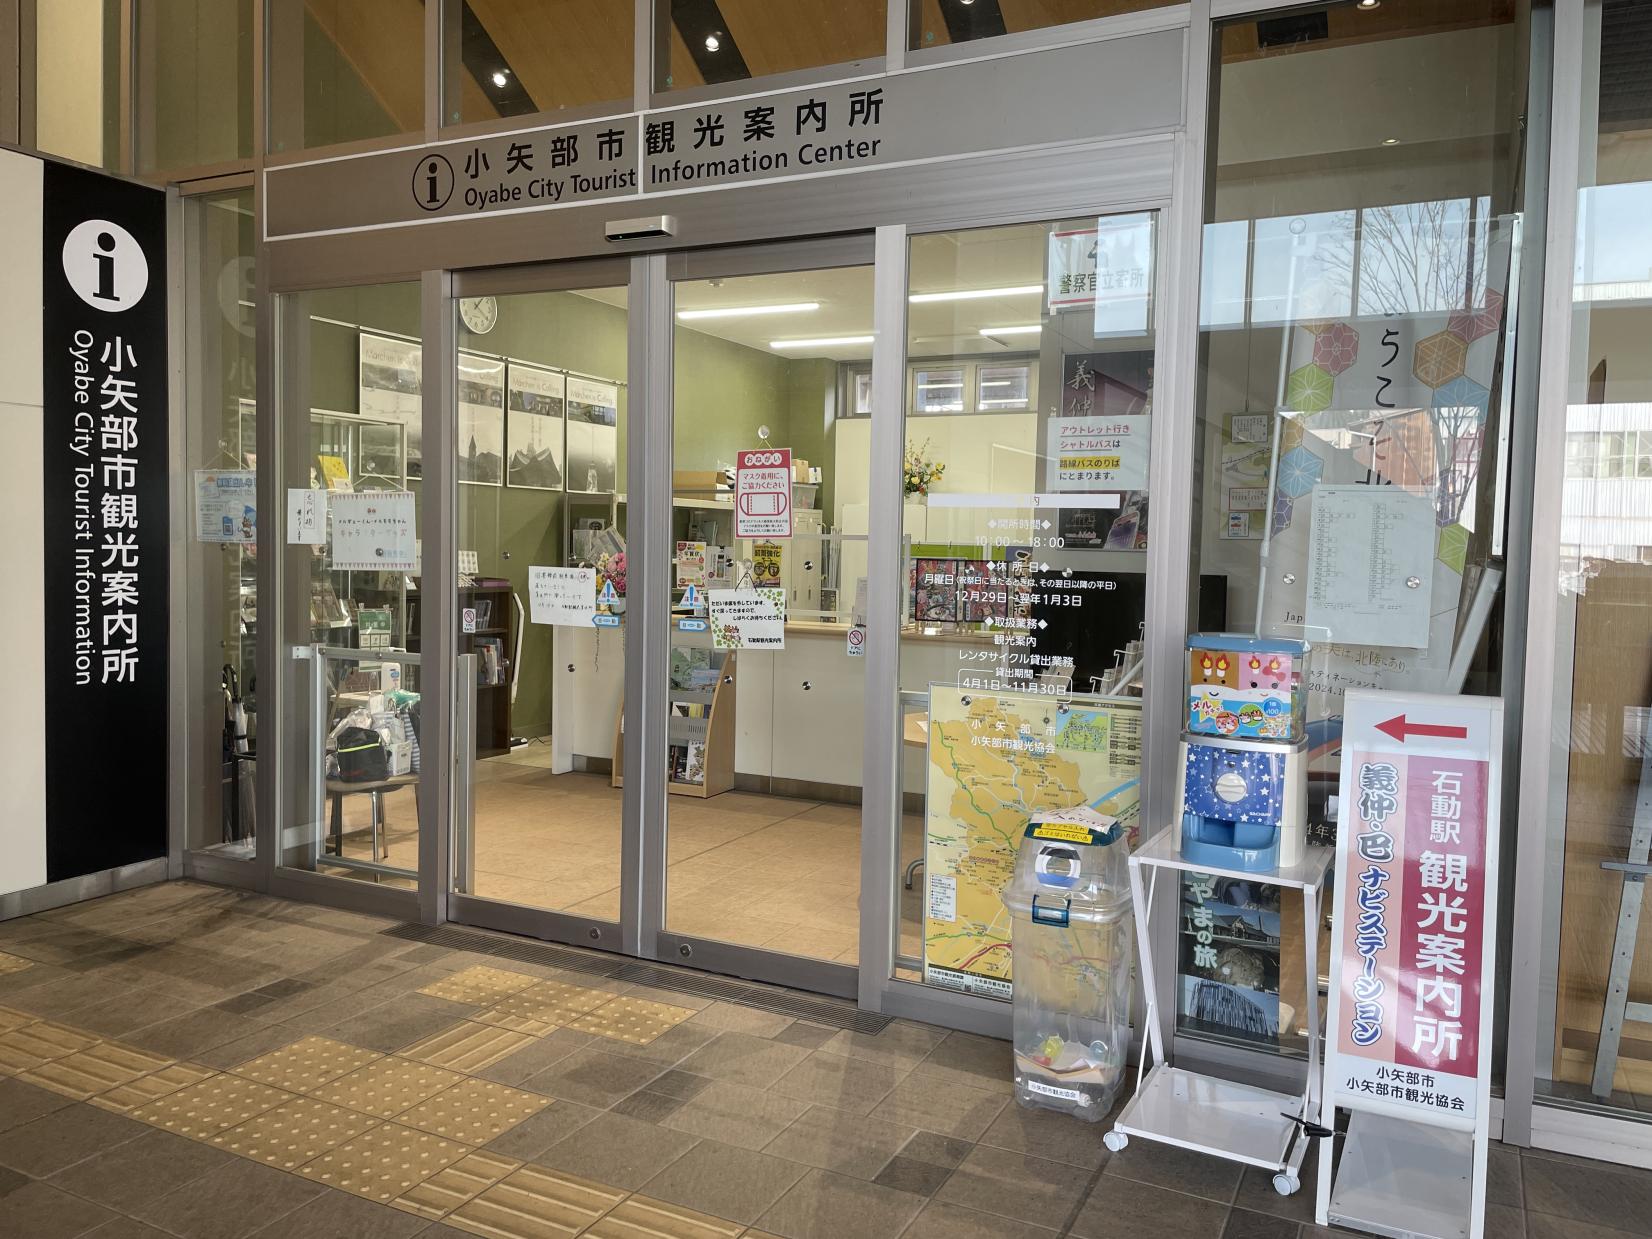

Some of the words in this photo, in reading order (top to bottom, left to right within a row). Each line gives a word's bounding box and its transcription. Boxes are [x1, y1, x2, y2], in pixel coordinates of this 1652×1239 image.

[464, 87, 884, 179] 小矢部市観光案内所
[465, 182, 522, 210] Oyabe
[528, 177, 565, 201] City
[570, 168, 637, 194] Tourist
[651, 150, 788, 184] Information
[798, 136, 881, 166] Center
[69, 328, 94, 405] Oyabe
[69, 411, 94, 457] City
[1061, 424, 1130, 434] アウトレット行き
[1060, 439, 1120, 449] シャトルバスは
[746, 453, 781, 465] おねがい
[1060, 457, 1120, 469] 路線バスのりば
[742, 481, 785, 490] ご協力ください
[1060, 471, 1115, 481] にとまります。
[72, 463, 94, 541] Tourist
[99, 335, 140, 685] 小矢部市観光案内所
[74, 547, 95, 686] Information
[994, 616, 1038, 630] 取扱業務
[993, 634, 1037, 648] 観光案内
[959, 649, 1074, 669] レンタサイクル貸出業務
[995, 667, 1034, 679] 貸出期間
[971, 718, 1056, 737] 小矢部市
[971, 736, 1056, 754] 小矢部市観光協会
[1357, 762, 1399, 863] 義仲・巴
[1429, 769, 1464, 845] 石動駅
[1350, 866, 1391, 1046] ナビステーション
[1411, 849, 1469, 1061] 観光案内所
[1376, 1066, 1436, 1088] 小矢部市
[1345, 1076, 1465, 1112] 小矢部市観光協会
